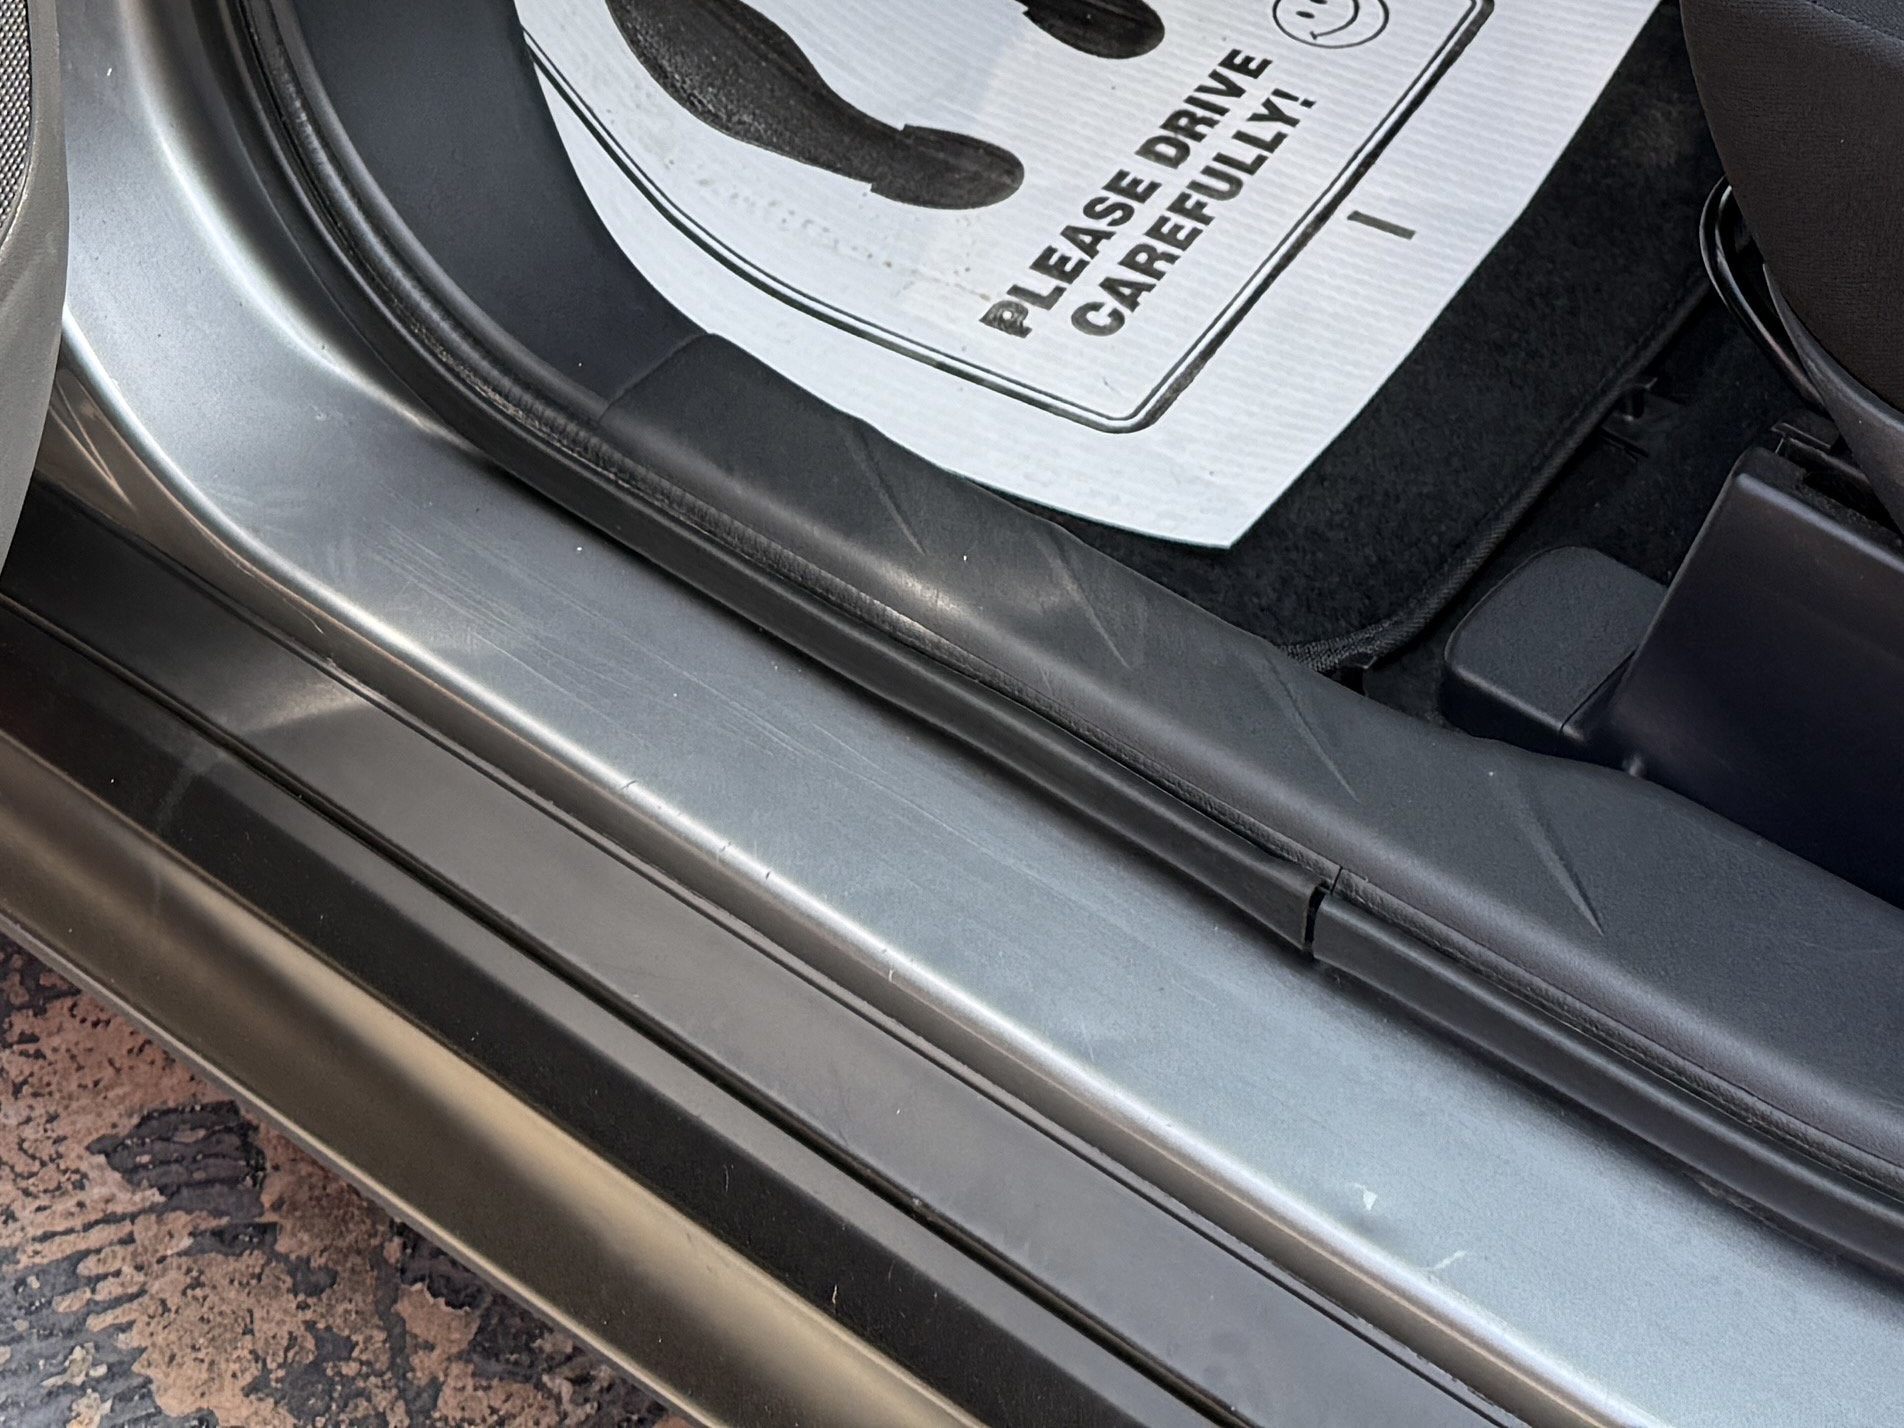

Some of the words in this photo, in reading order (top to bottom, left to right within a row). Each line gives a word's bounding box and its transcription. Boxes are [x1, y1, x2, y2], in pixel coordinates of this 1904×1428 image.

[978, 167, 1163, 339] PLEASE
[1133, 47, 1274, 170] DRIVE
[1070, 87, 1318, 338] CAREFULLY!
